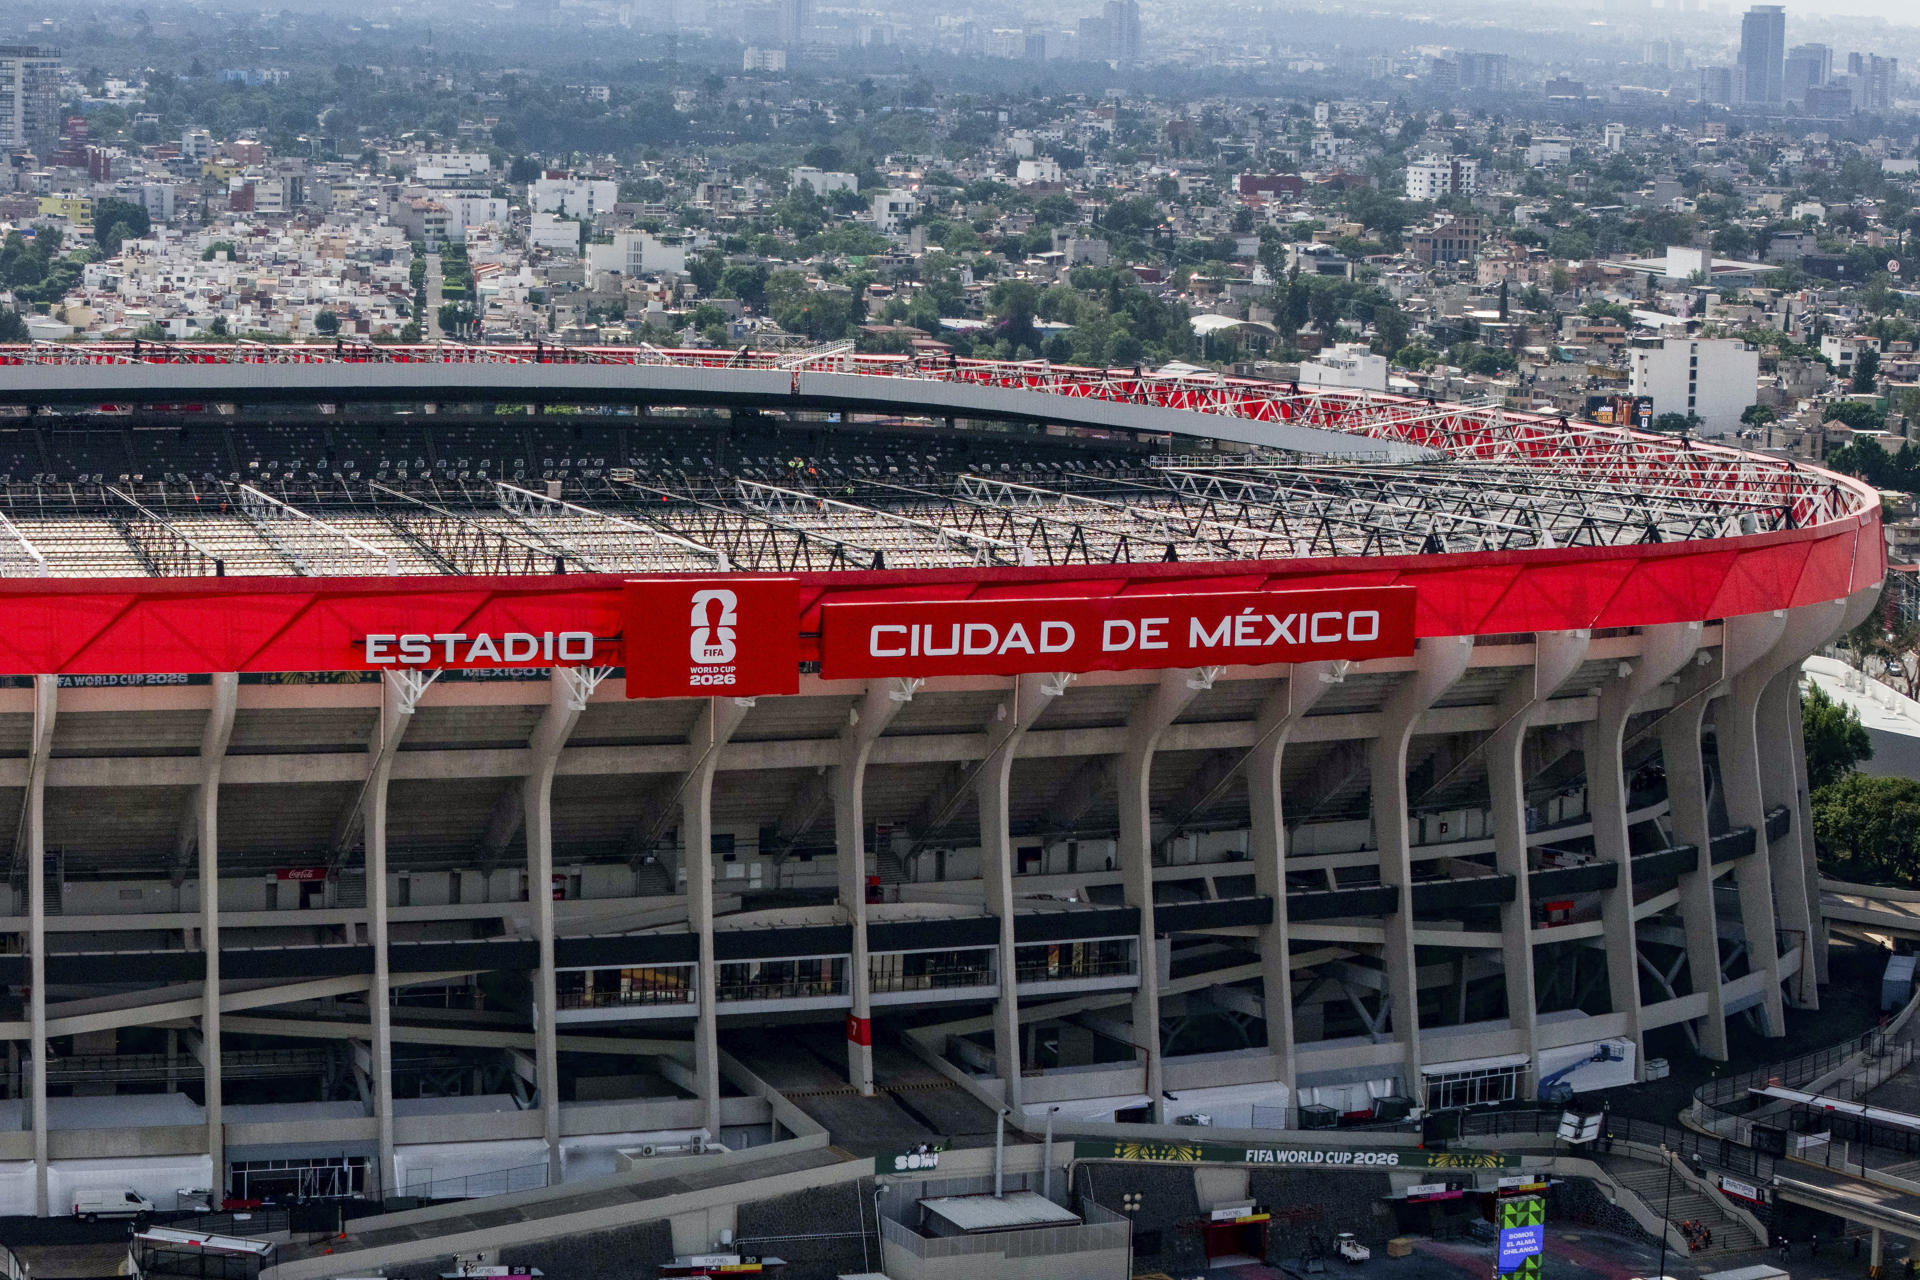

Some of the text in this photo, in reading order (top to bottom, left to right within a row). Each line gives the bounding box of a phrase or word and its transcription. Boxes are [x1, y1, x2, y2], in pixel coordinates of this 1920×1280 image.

[869, 607, 1380, 657] CIUDAD DE MÉXICO
[366, 631, 594, 664] ESTADIO
[703, 648, 724, 656] FIFA
[58, 673, 188, 686] FA WORLD CUP 2026
[690, 674, 736, 686] 2026
[851, 1020, 857, 1036] 7
[1246, 1150, 1399, 1165] FIFA WORLD CUP 2026
[1508, 1231, 1535, 1240] SOMOS
[1516, 1238, 1537, 1247] ALMA
[1503, 1245, 1539, 1255] CHILANGA
[745, 1256, 757, 1264] 30
[513, 1266, 526, 1275] 29
